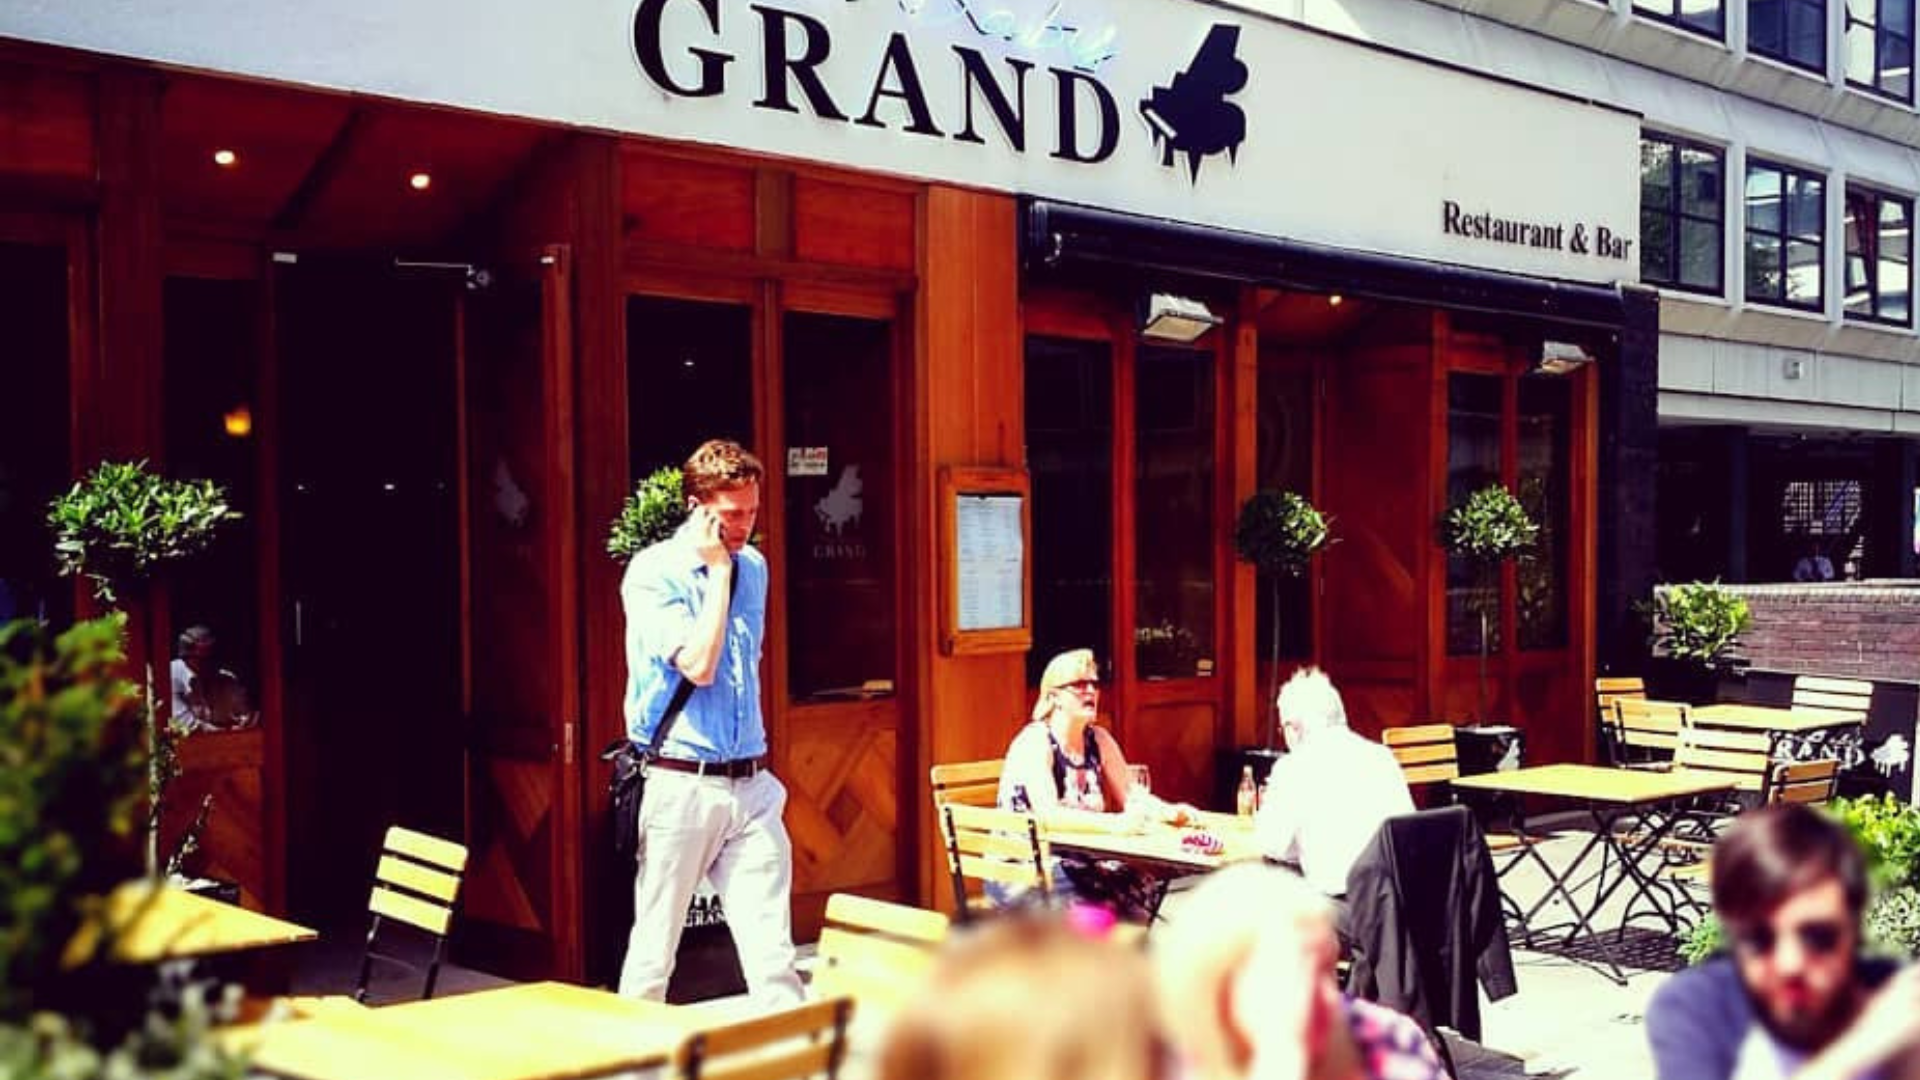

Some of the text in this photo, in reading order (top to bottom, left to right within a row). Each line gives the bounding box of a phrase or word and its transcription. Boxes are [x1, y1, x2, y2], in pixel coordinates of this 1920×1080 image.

[632, 0, 1122, 165] GRAND
[1442, 199, 1632, 261] Restaurant & Bar
[1774, 738, 1866, 770] RAND
